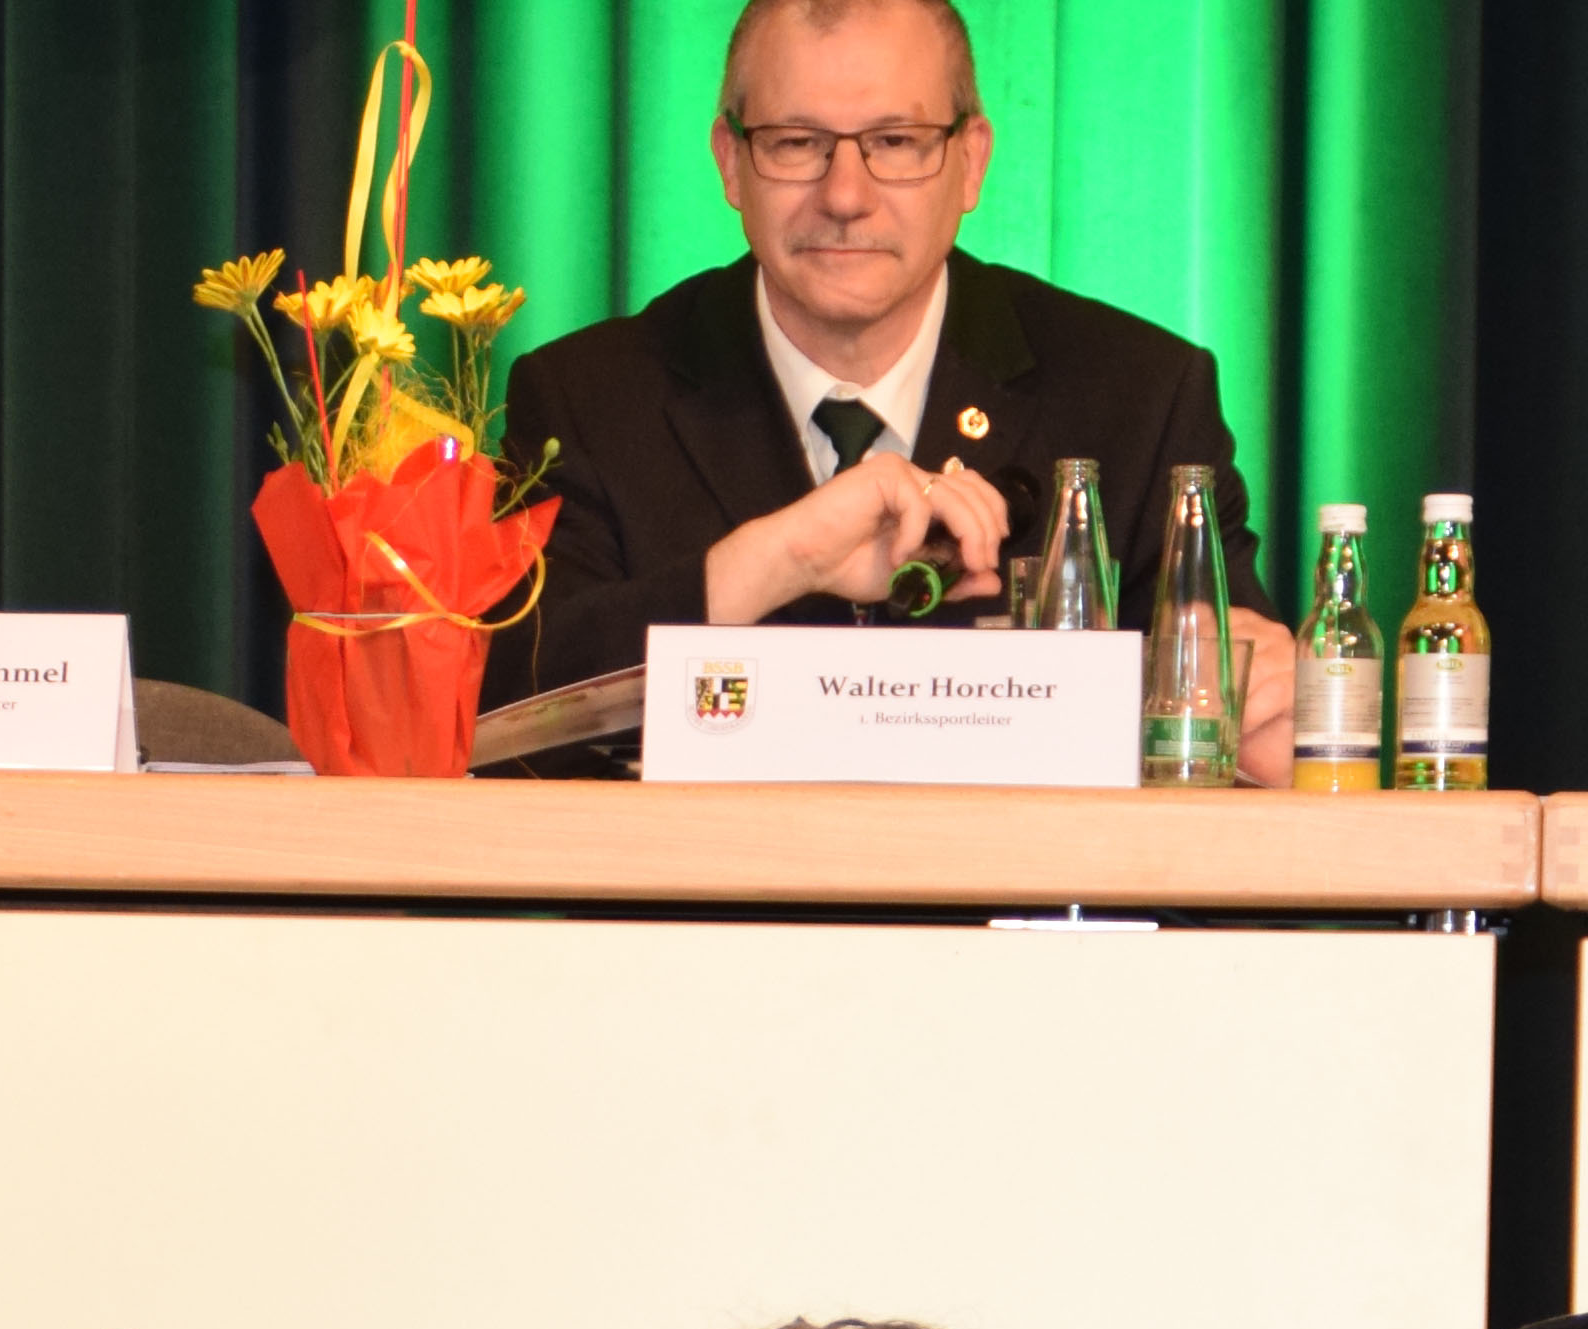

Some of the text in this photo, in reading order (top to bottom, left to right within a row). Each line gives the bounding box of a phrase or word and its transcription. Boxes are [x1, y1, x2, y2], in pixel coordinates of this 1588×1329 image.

[818, 675, 1057, 699] Walter Horcher
[875, 711, 1013, 728] Bezirkssportleiter
